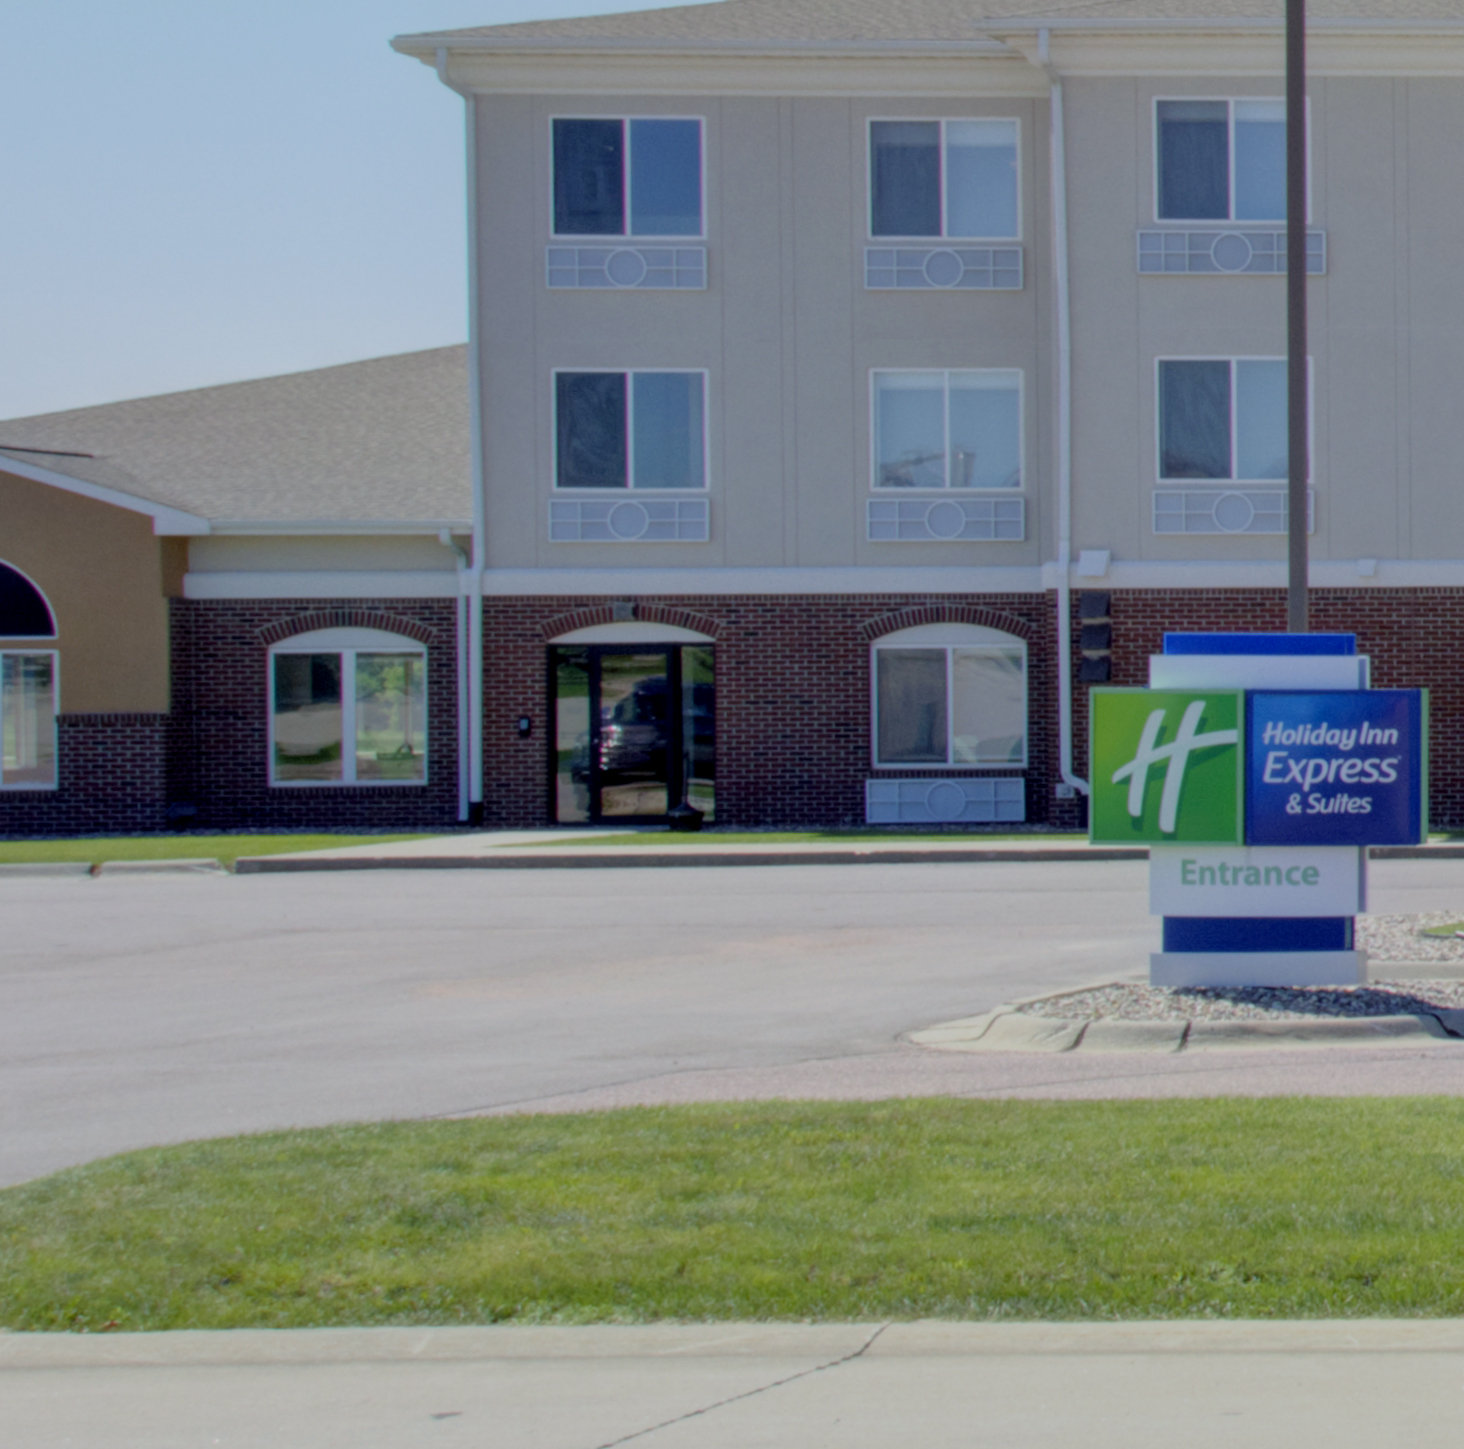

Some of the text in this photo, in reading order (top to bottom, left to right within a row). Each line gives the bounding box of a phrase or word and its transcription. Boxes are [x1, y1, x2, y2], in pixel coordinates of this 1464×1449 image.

[1262, 721, 1399, 750] Holiday Inn
[1263, 751, 1399, 792] Express
[1286, 792, 1373, 814] & Suites
[1180, 859, 1320, 886] Entrance
